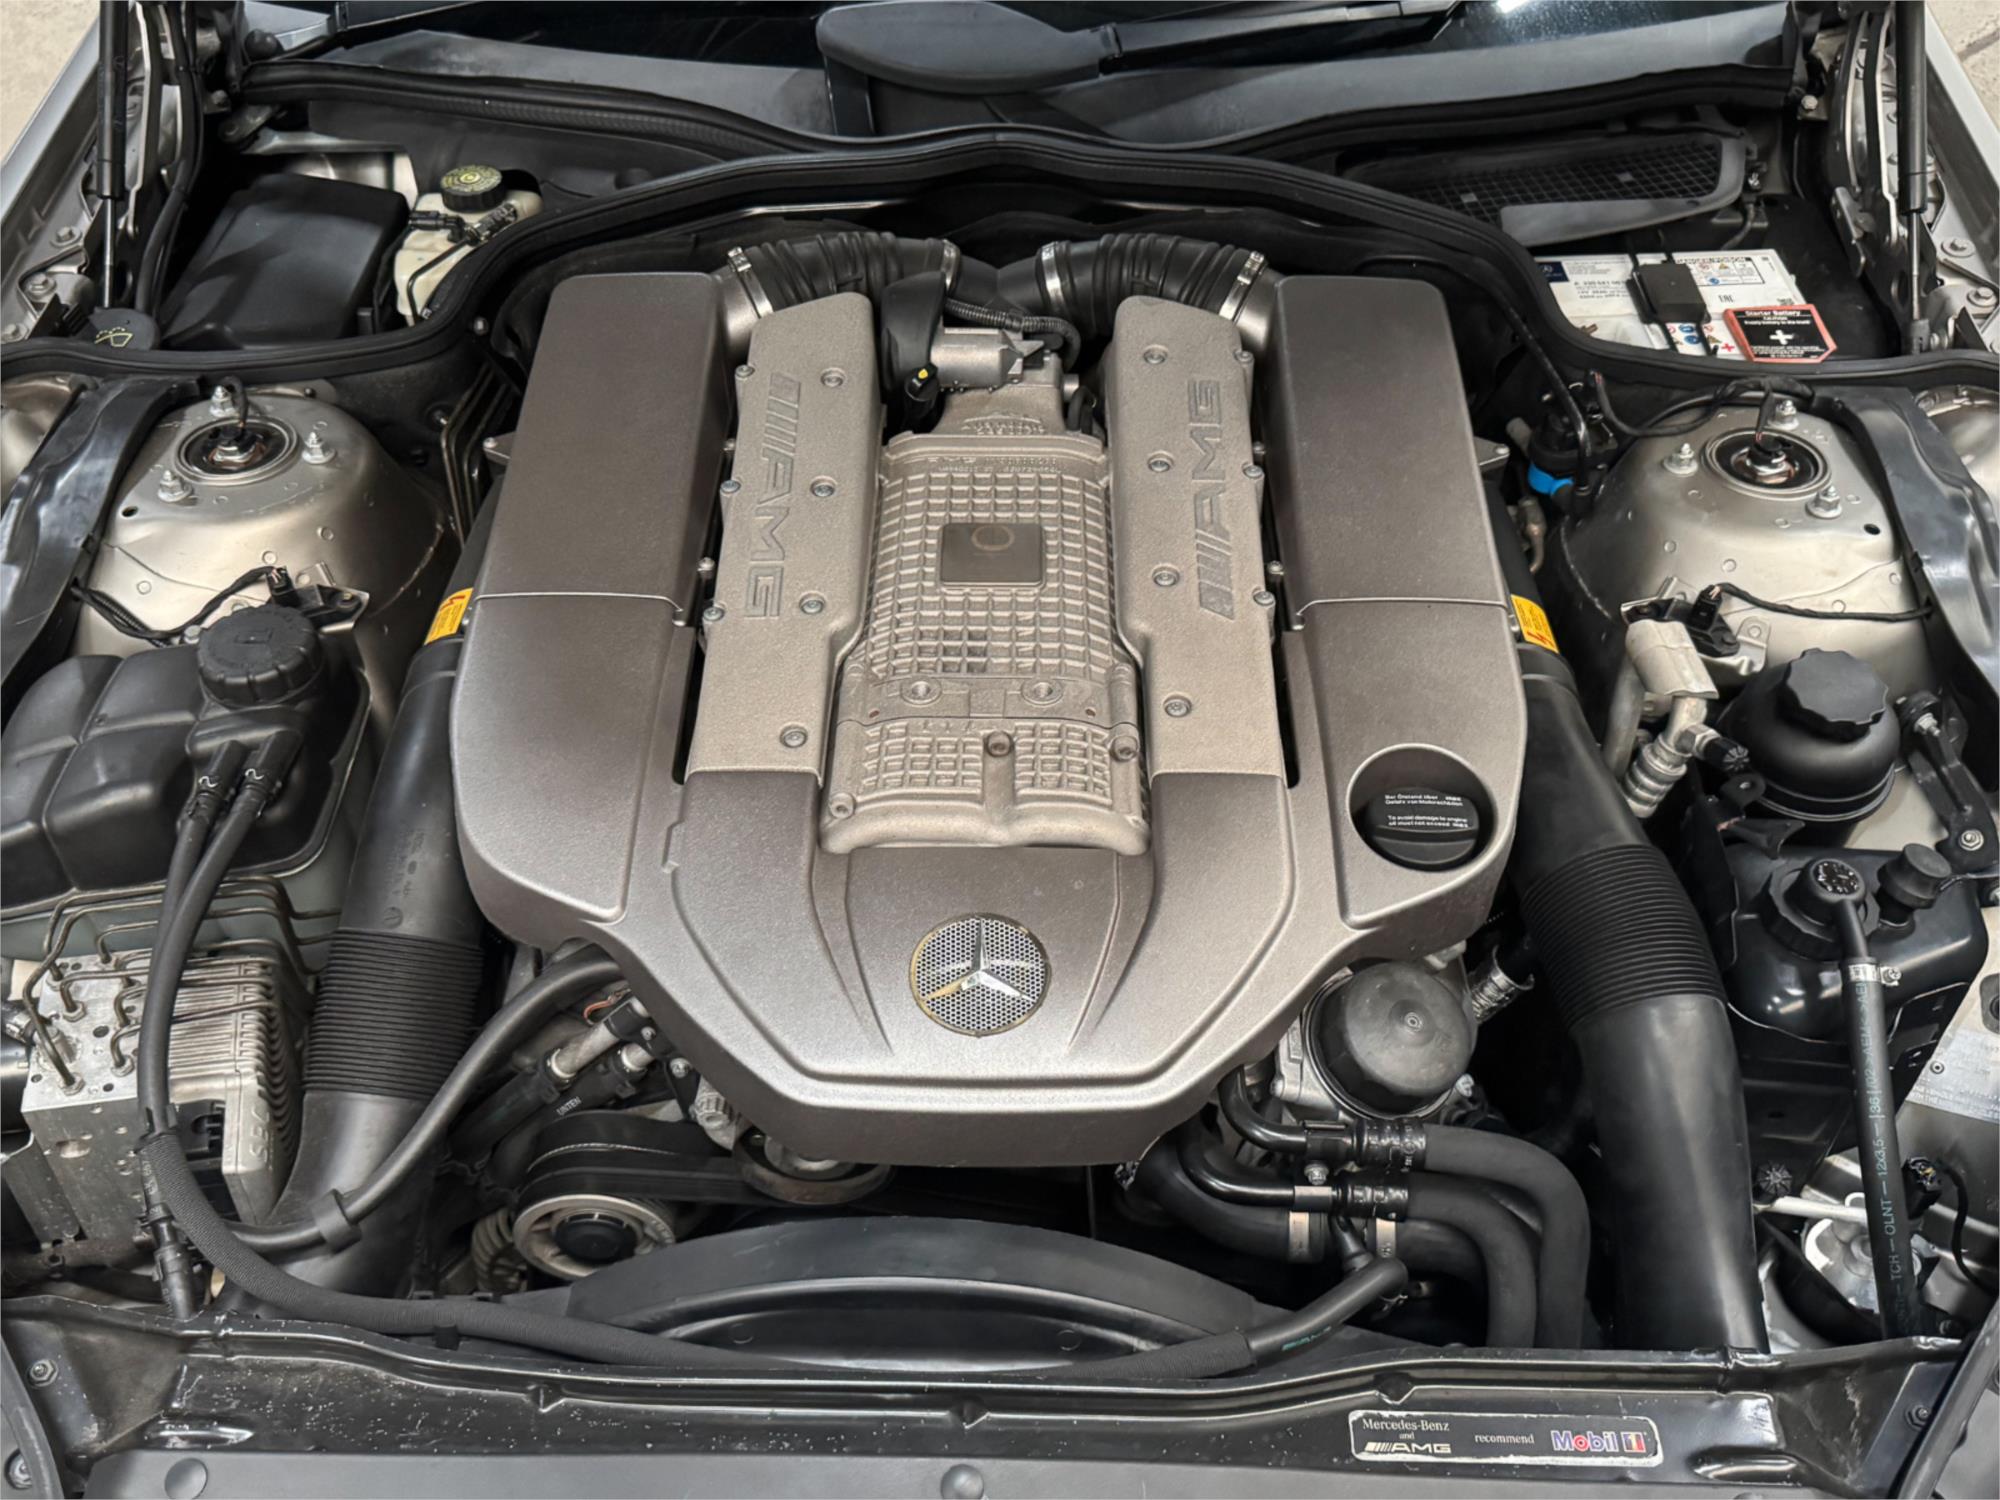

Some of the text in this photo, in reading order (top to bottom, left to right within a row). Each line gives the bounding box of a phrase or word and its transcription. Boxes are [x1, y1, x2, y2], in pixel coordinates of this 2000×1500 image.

[1188, 379, 1229, 543] AMG
[744, 446, 796, 618] AMG
[1880, 1198, 1897, 1236] OLNT
[1889, 1254, 1903, 1280] TCH
[1363, 1418, 1450, 1432] Mercedes-Benz
[1399, 1432, 1415, 1440] and
[1391, 1442, 1452, 1454] AMG
[1475, 1433, 1535, 1445] recommend
[1550, 1430, 1619, 1453] Mobil
